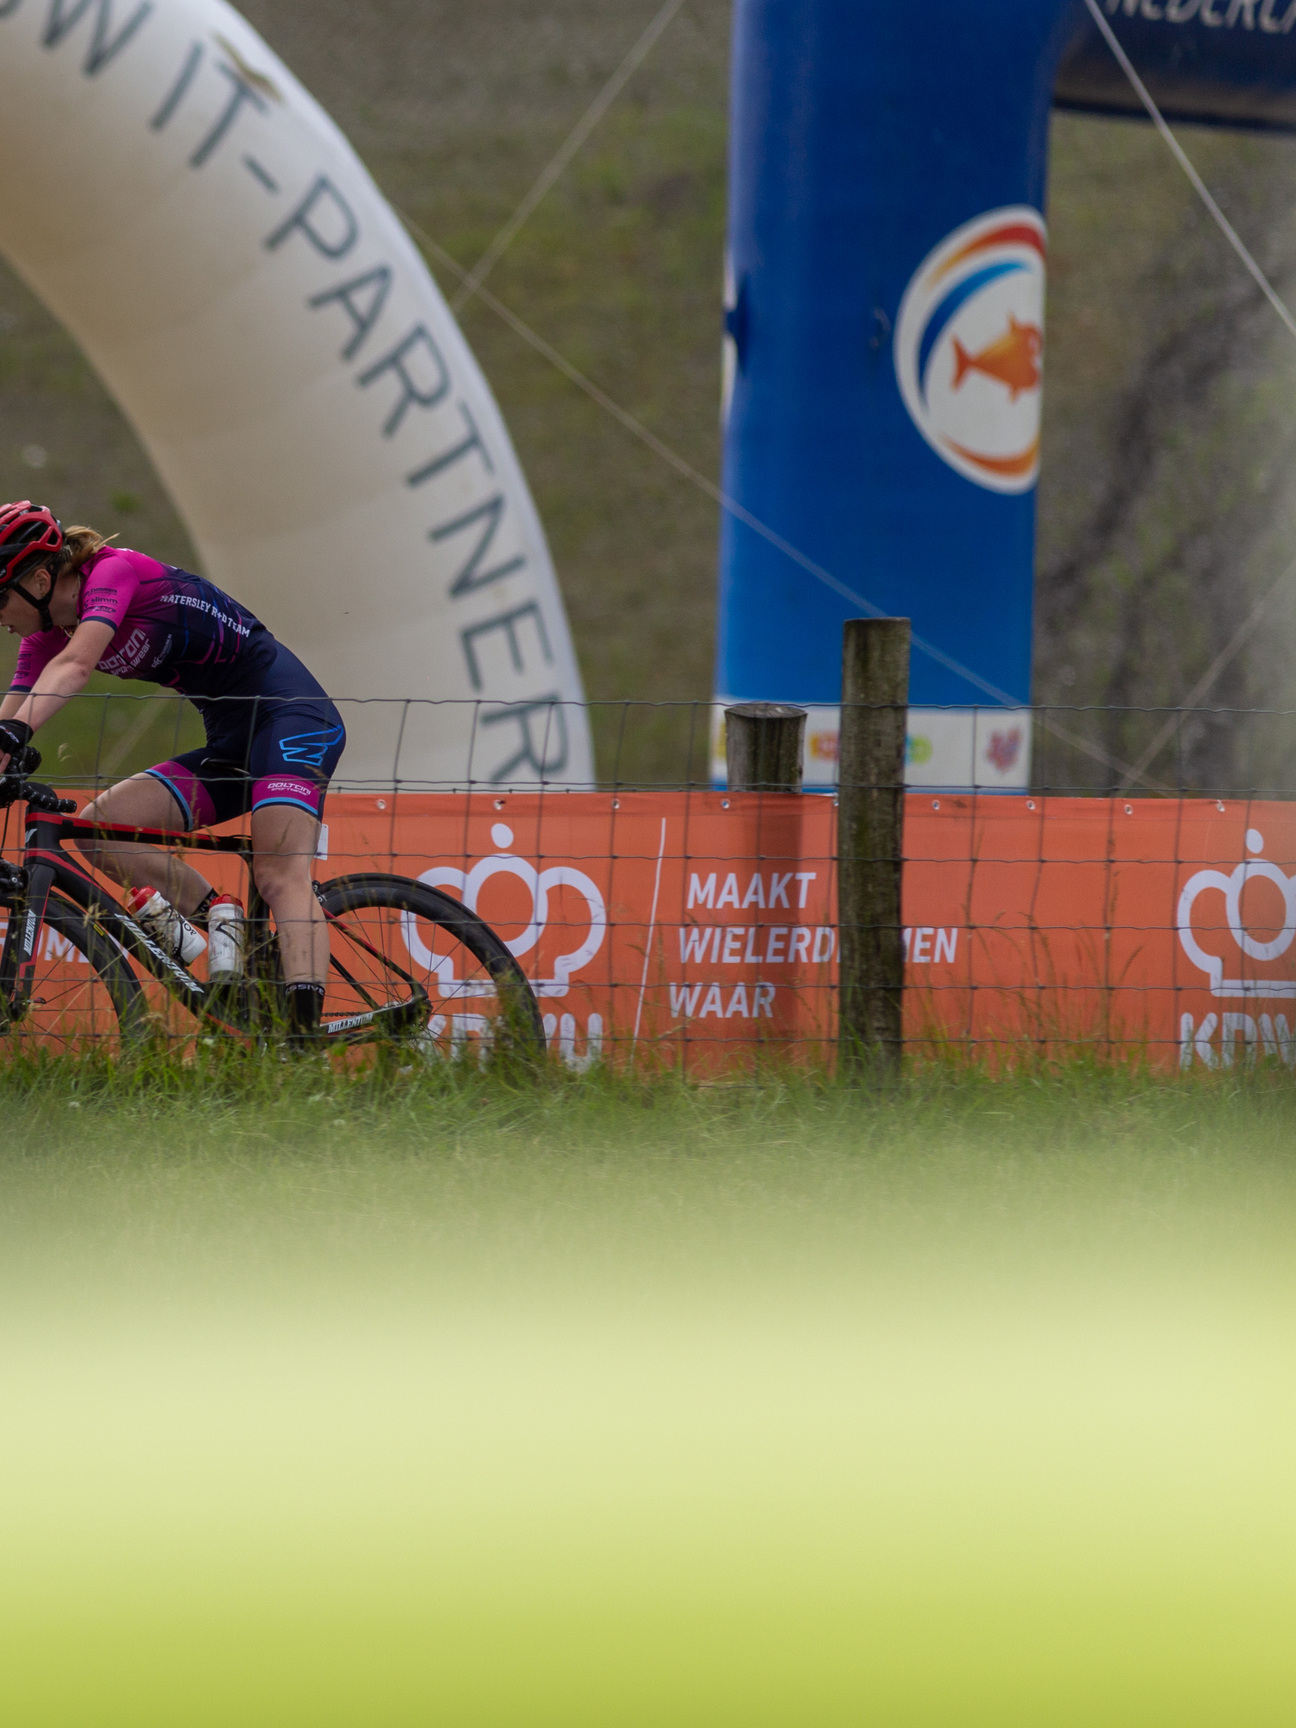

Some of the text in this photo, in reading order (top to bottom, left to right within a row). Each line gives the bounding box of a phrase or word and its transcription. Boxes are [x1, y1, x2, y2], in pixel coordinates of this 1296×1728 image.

[227, 617, 251, 638] TEAM
[686, 872, 817, 909] MAAKT
[679, 927, 959, 964] WIELERDEN
[669, 982, 777, 1019] WAAR
